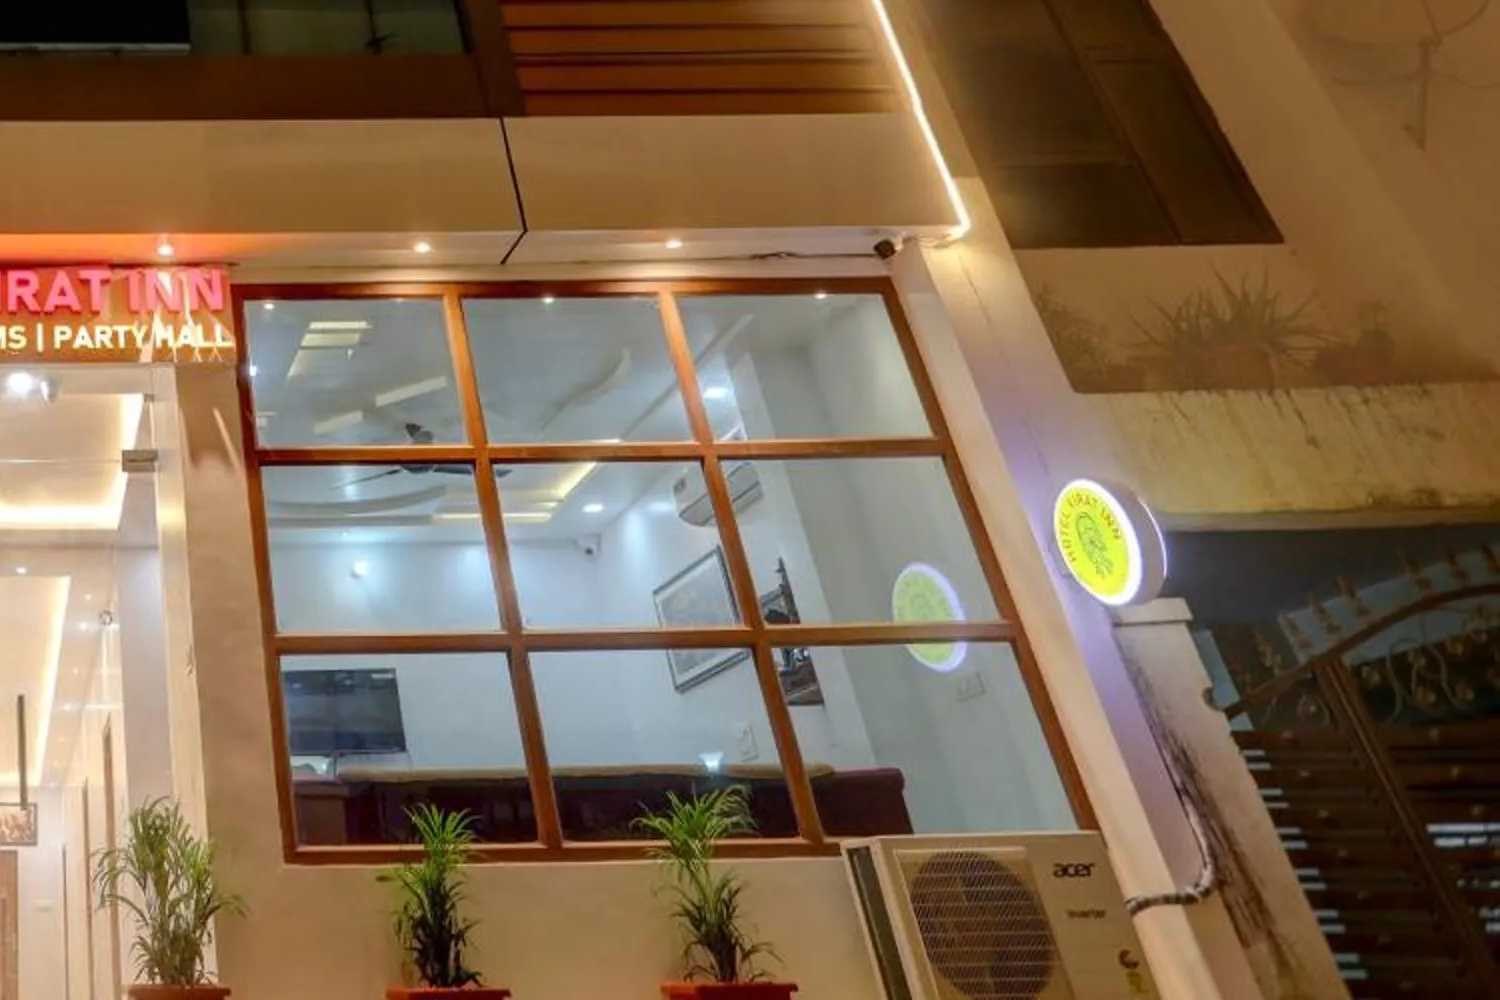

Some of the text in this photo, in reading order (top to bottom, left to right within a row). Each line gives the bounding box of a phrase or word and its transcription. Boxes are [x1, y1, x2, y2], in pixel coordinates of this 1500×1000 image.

[127, 267, 225, 316] INN
[53, 324, 148, 350] PARTY
[153, 324, 236, 350] HALL
[1052, 861, 1097, 878] acer
